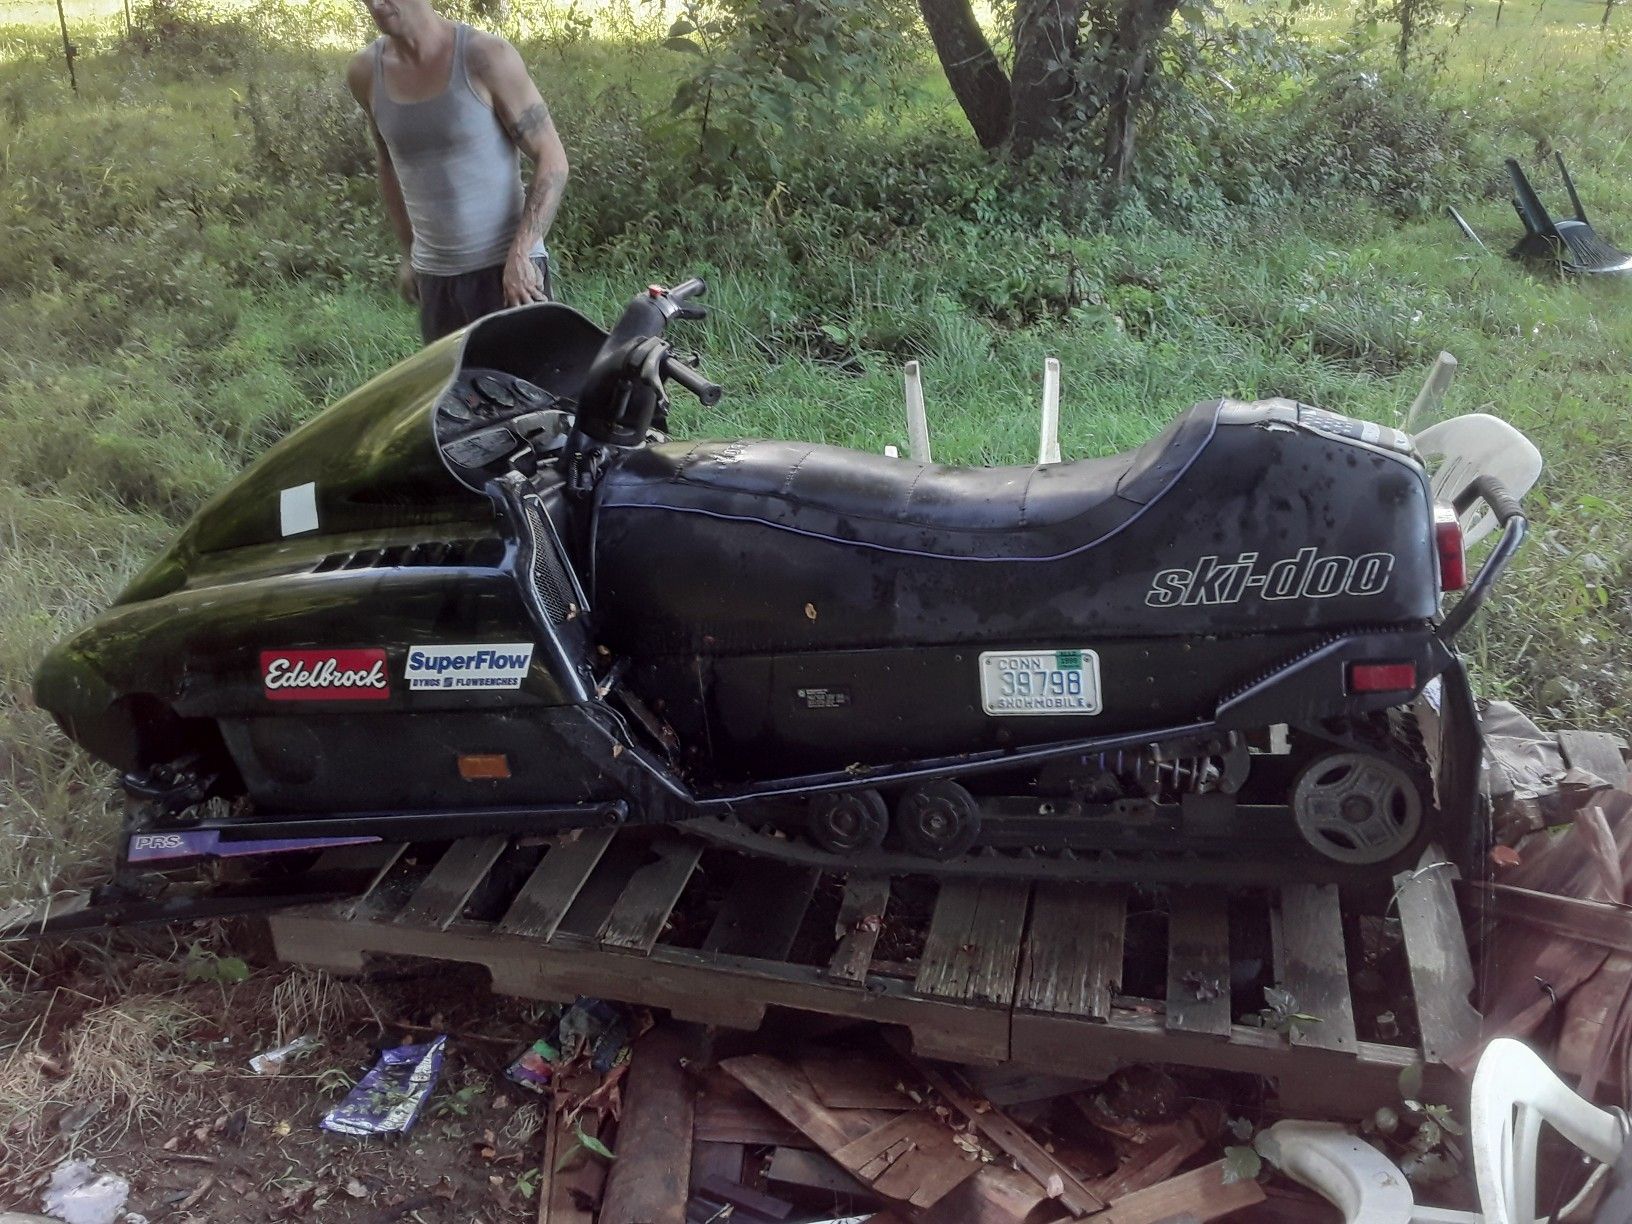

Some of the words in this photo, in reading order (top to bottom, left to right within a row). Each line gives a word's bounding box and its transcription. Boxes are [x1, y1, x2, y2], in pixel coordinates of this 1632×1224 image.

[1145, 547, 1395, 607] ski-doo
[409, 650, 529, 674] SuperFlow
[999, 658, 1041, 670] CONN
[265, 658, 386, 689] Edelbrock
[413, 679, 440, 687] DYNOS
[456, 678, 518, 686] FLOWBENCHES
[1000, 671, 1081, 696] 39798
[999, 698, 1086, 708] SNOWMOBILE
[136, 835, 183, 849] PRS
